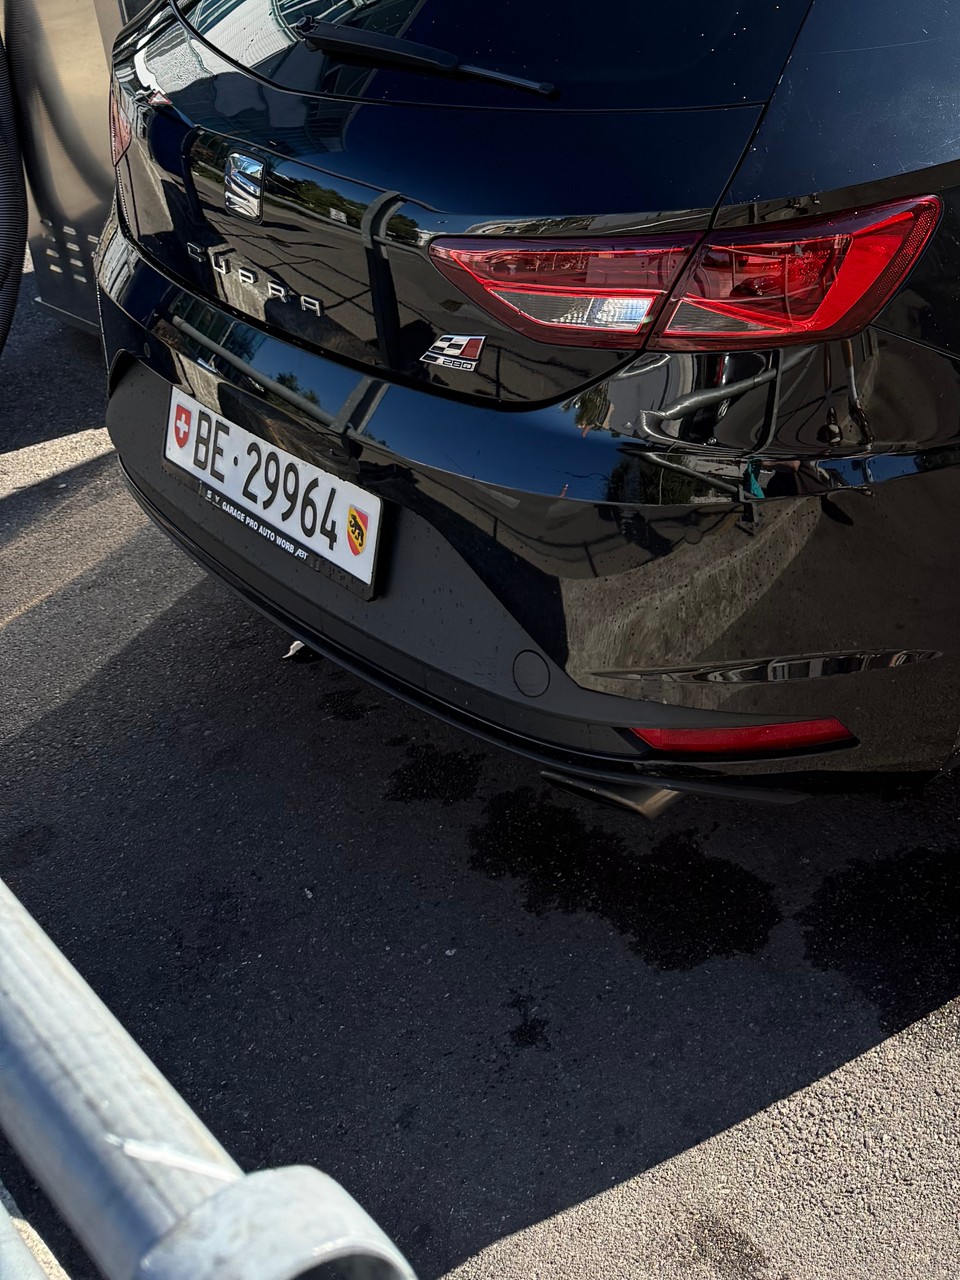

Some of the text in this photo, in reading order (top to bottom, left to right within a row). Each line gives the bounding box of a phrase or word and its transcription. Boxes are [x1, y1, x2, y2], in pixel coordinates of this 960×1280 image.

[186, 241, 324, 318] CUPRA
[442, 358, 473, 370] 280
[222, 502, 246, 522] GARAGE
[245, 516, 258, 530] PRO
[258, 526, 276, 542] AUTO
[276, 535, 295, 554] WORB
[242, 442, 338, 551] 29964
